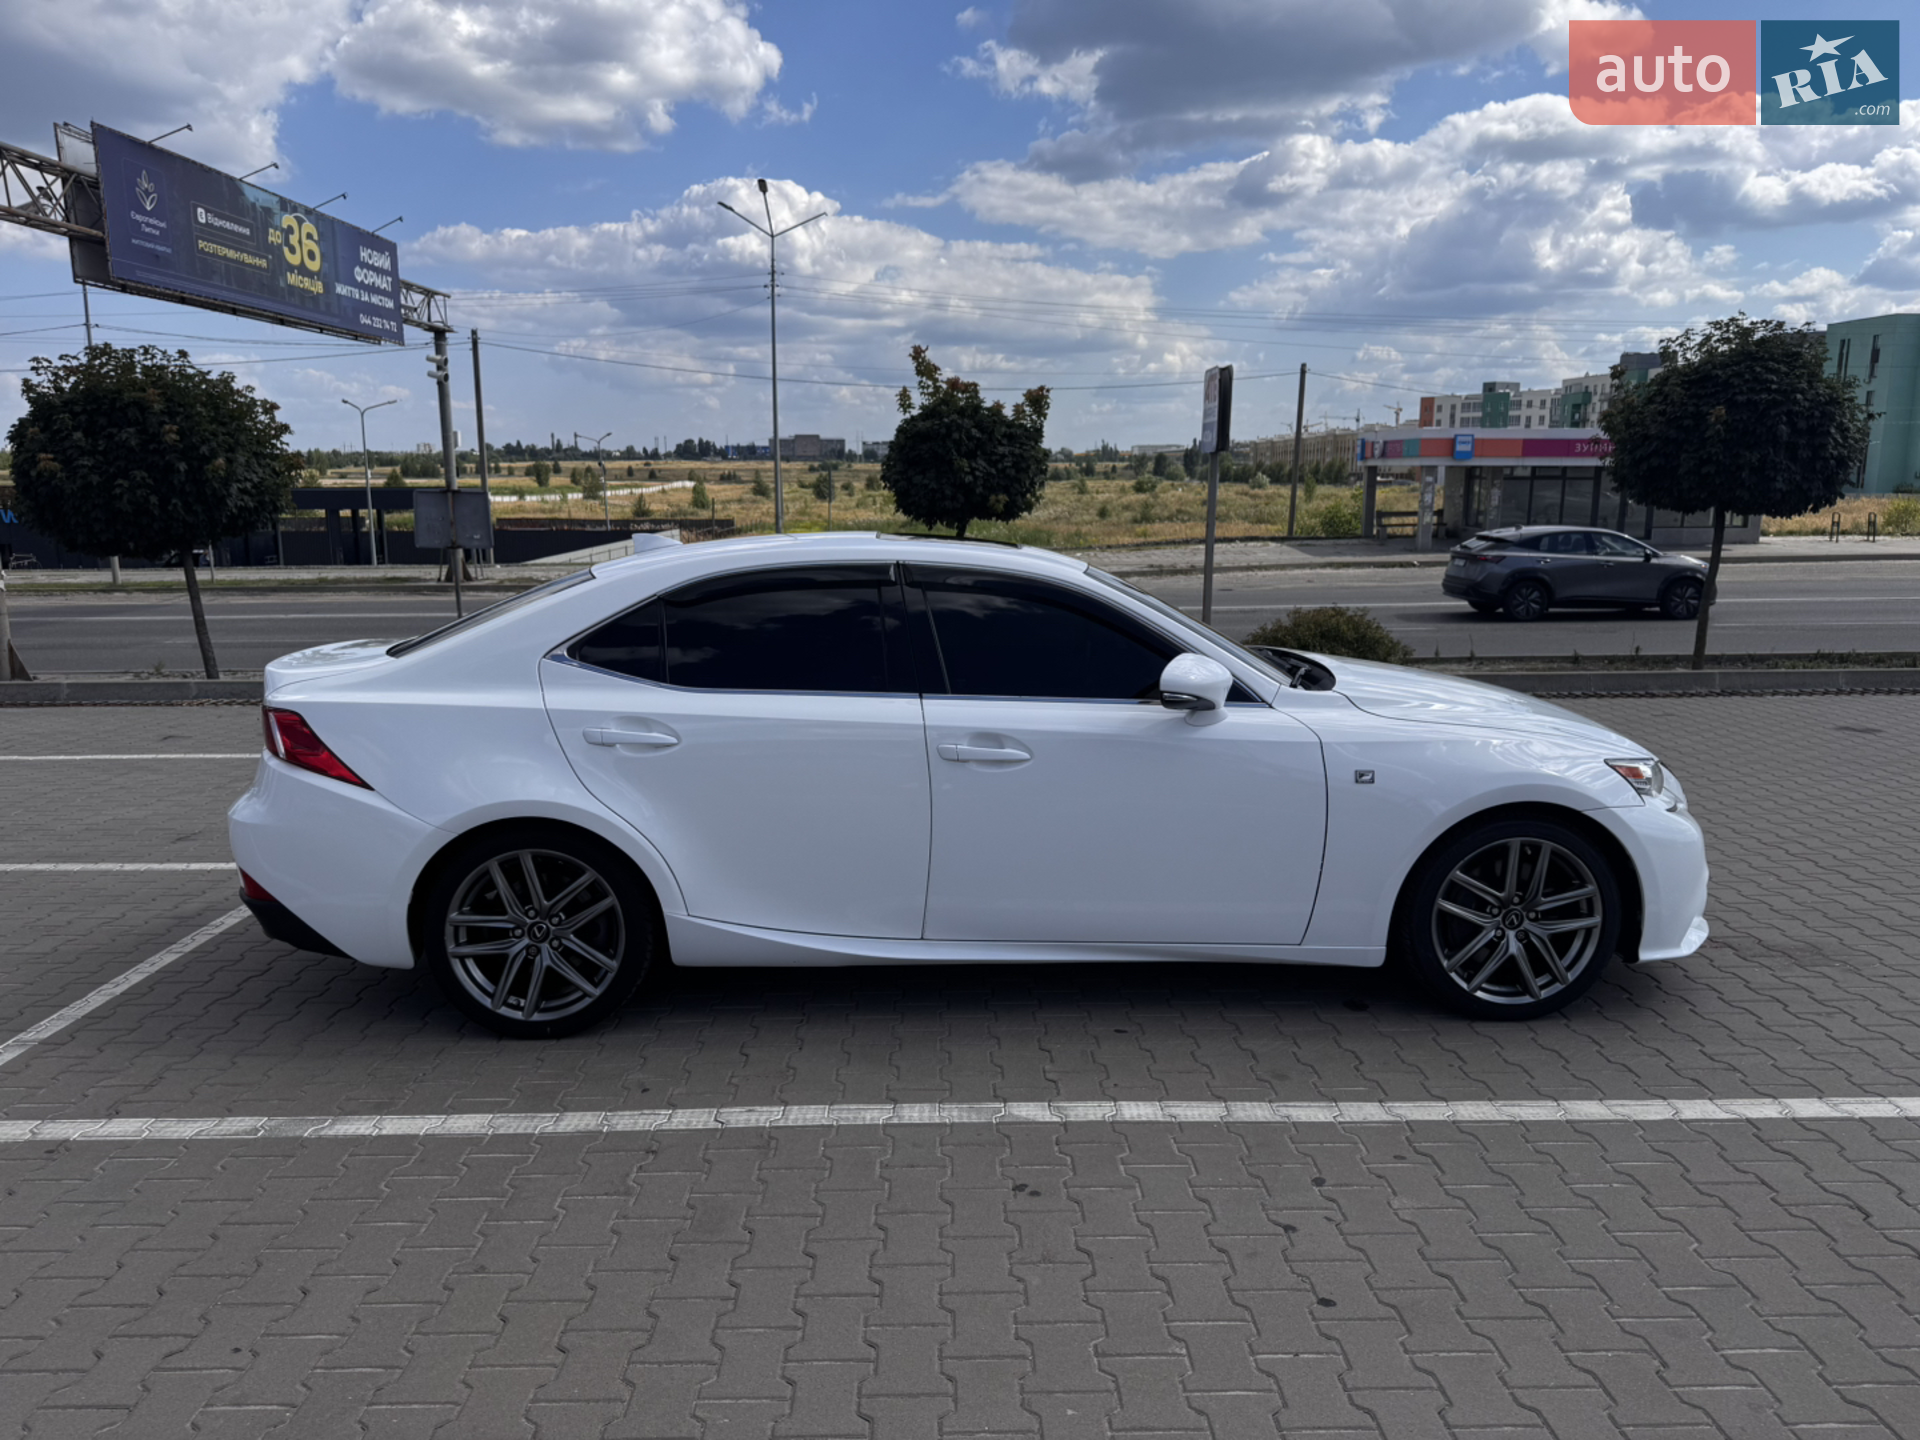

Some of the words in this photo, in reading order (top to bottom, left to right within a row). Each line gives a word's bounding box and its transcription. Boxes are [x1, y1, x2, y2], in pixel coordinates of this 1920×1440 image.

[281, 214, 321, 272] 36
[359, 245, 391, 271] НОВИЙ
[354, 265, 393, 292] ФОРМАТ
[334, 282, 360, 300] ЖИТТЯ
[360, 290, 370, 304] ЗА
[369, 292, 395, 310] МІСТОМ
[1574, 442, 1617, 453] ЗУПИН
